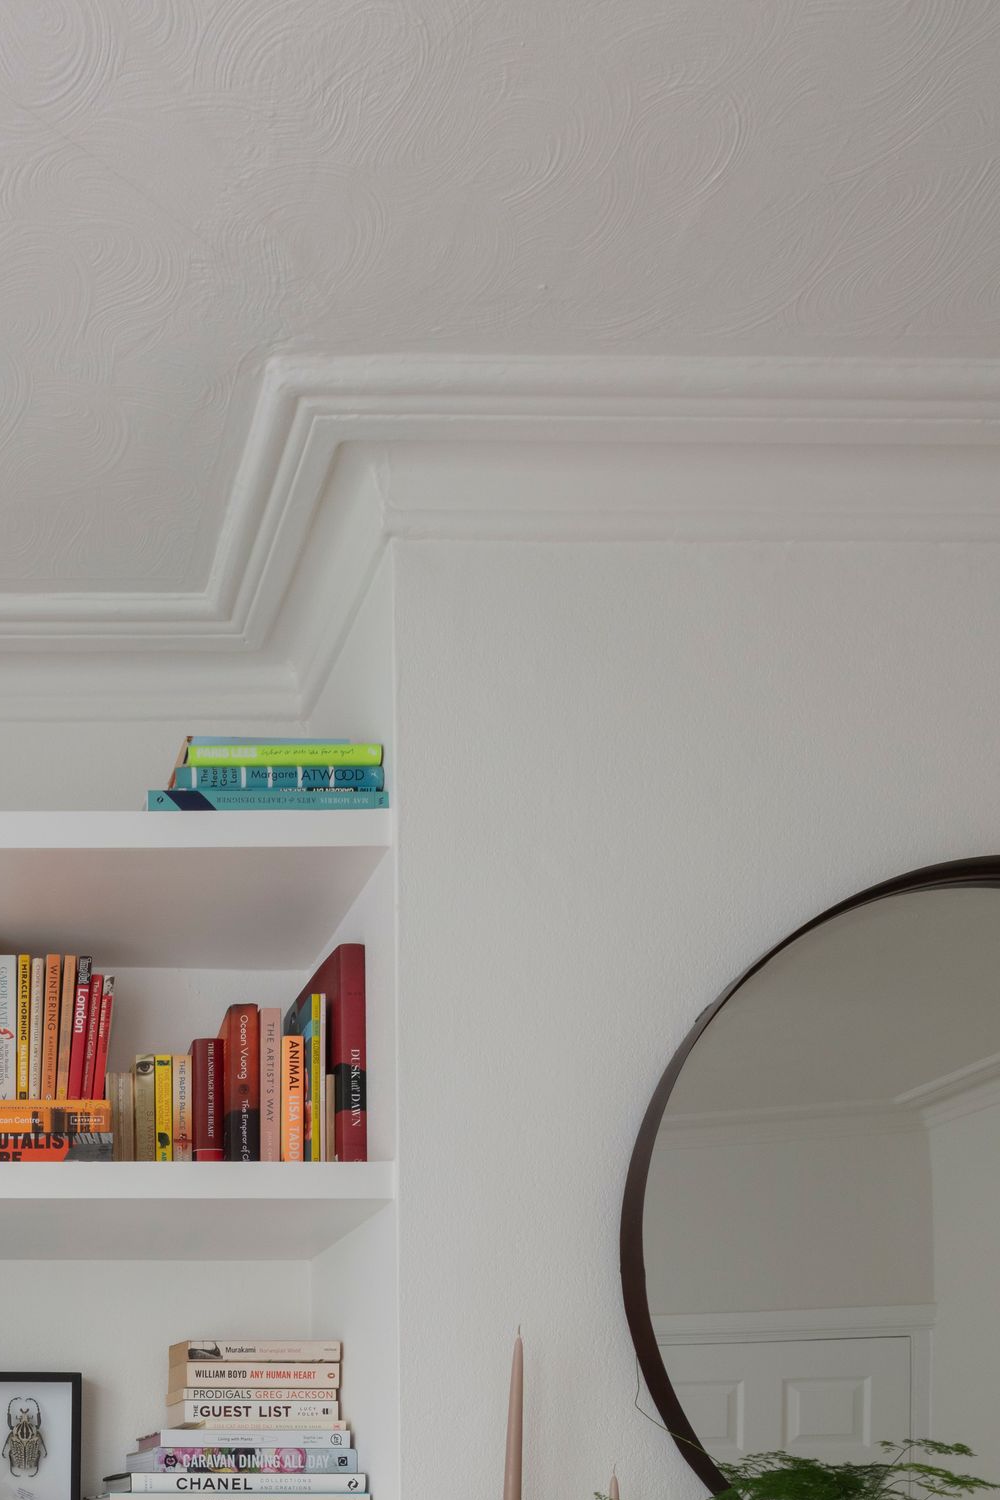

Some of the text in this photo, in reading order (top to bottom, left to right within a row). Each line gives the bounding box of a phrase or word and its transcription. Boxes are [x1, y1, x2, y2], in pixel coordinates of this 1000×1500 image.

[201, 768, 209, 783] The
[251, 770, 298, 781] Margaret
[301, 769, 365, 781] ATWOOD
[0, 966, 8, 999] GABOR
[46, 964, 58, 1031] WINTERING
[74, 988, 88, 1033] London
[237, 1015, 249, 1080] Ocean Vuong
[266, 1023, 275, 1122] THE ARTIST'S WAY
[289, 1040, 300, 1091] ANIMAL
[351, 1049, 361, 1127] DUSK DAWN
[289, 1095, 301, 1122] LISA
[14, 1115, 40, 1125] Centre
[239, 1100, 249, 1144] The Emperor
[195, 1370, 316, 1379] WILLIAM BOYD ANY HUMAN HEART
[193, 1389, 334, 1399] PRODIGALS GREG JACKSON
[200, 1405, 292, 1418] GUEST LIST
[183, 1454, 329, 1469] CARAVAN DINING ALL DAY
[176, 1477, 253, 1490] CHANEL
